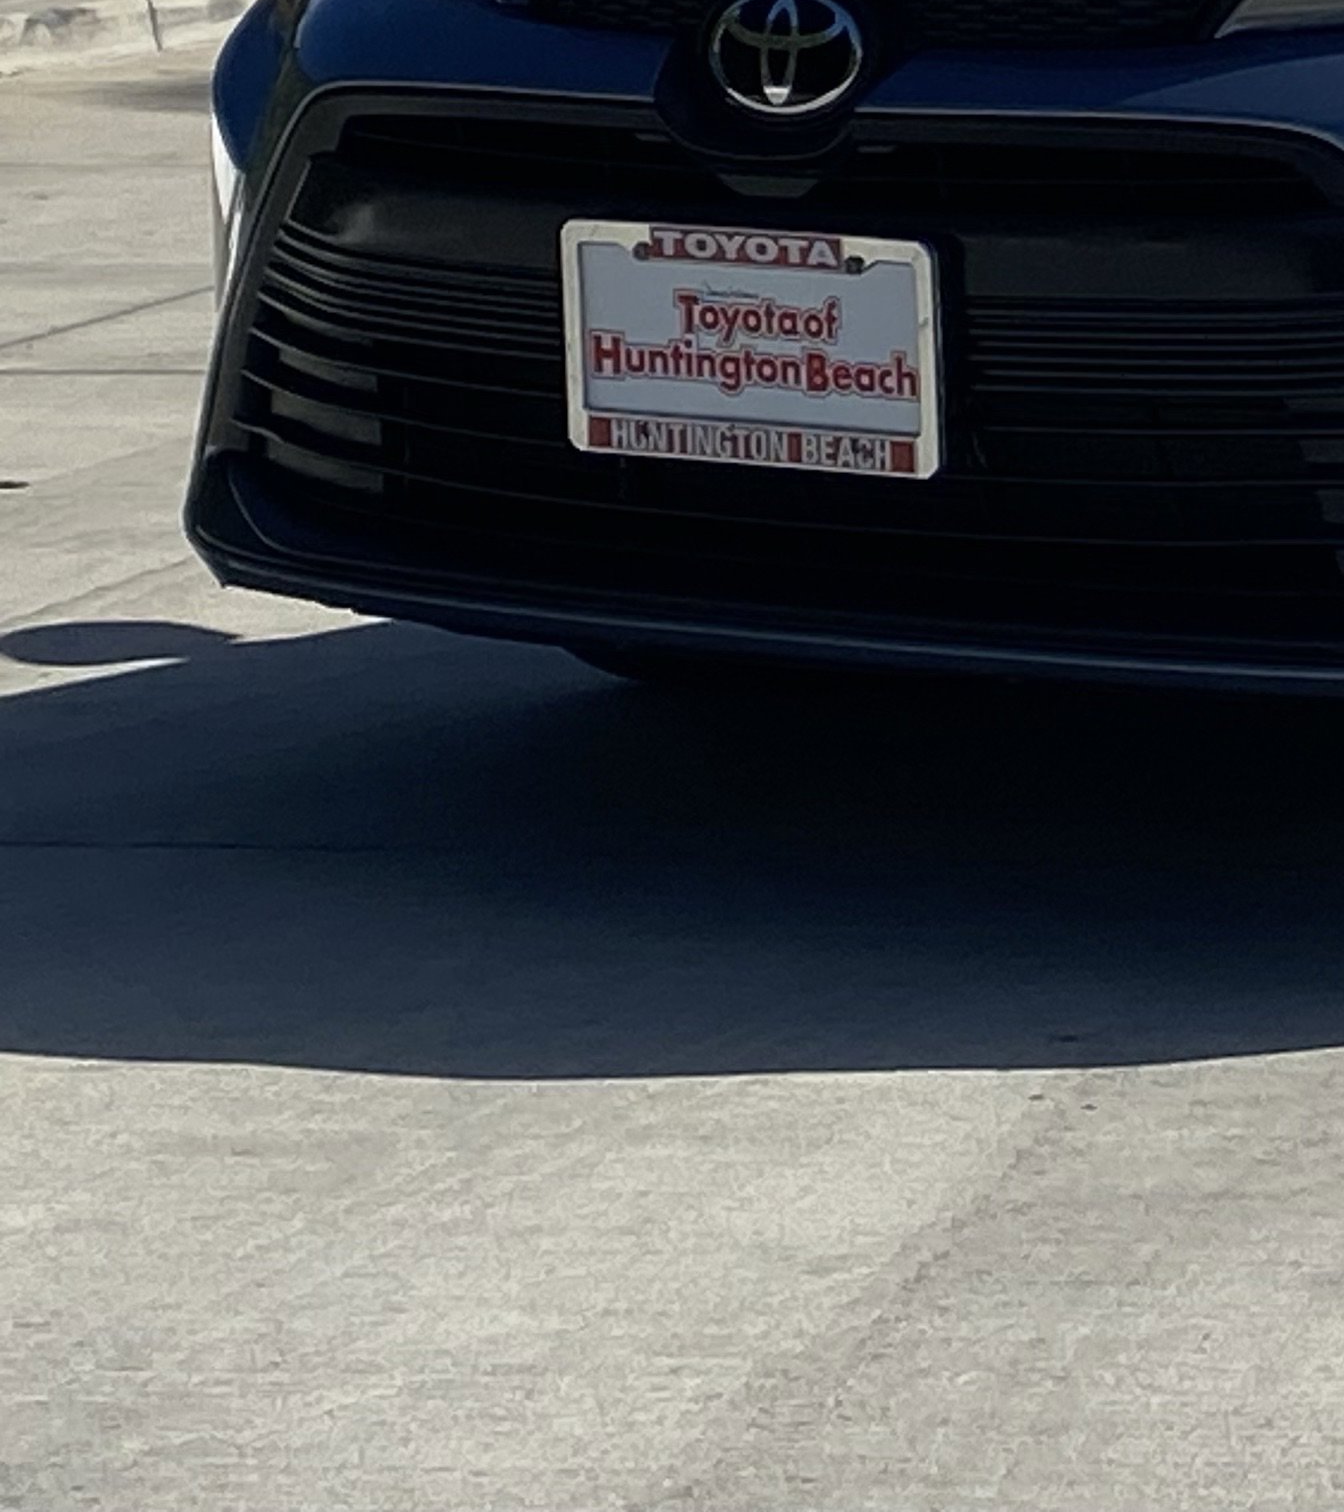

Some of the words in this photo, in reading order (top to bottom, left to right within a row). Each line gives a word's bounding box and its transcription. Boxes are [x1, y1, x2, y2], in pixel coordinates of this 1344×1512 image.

[651, 229, 840, 268] TOYOTA
[675, 289, 801, 345] Toyota
[802, 297, 840, 341] of
[590, 333, 803, 391] Huntington
[804, 350, 918, 399] Beach
[610, 417, 789, 464] HUNTINGTON
[801, 433, 891, 473] BEACH
